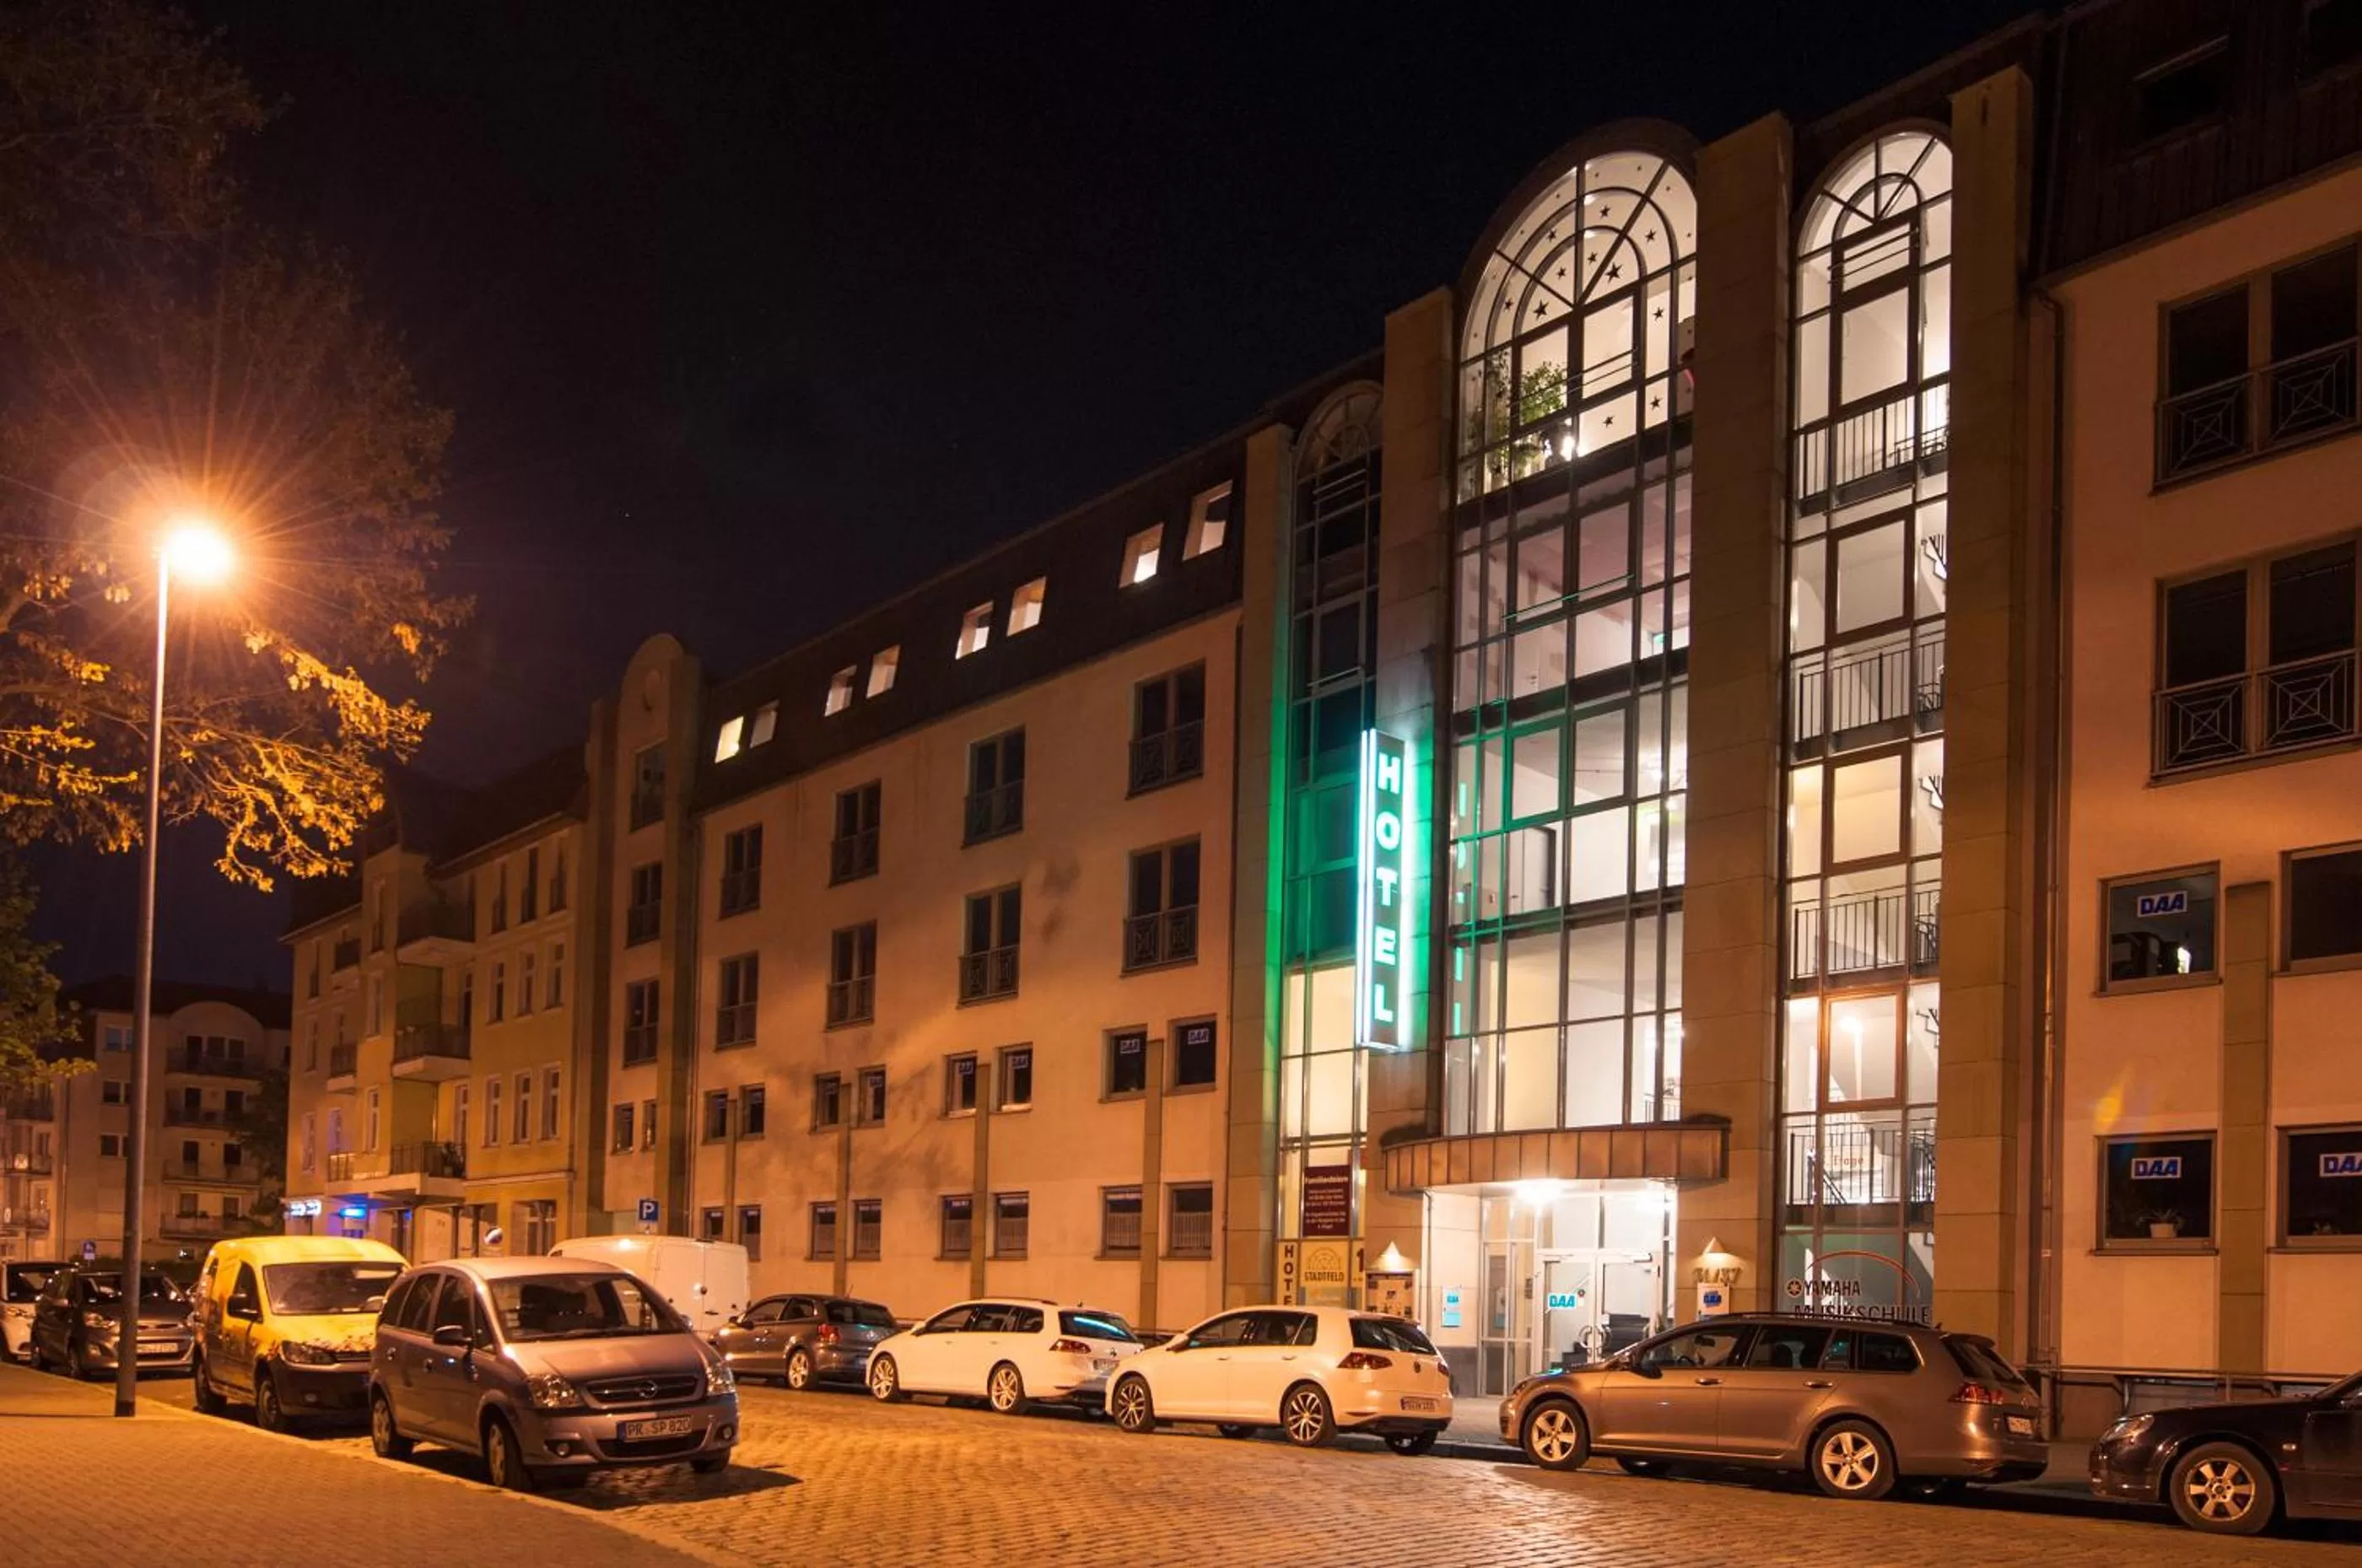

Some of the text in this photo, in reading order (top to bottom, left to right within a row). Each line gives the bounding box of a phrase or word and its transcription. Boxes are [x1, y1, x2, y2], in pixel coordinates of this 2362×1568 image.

[1373, 752, 1401, 1023] HOTEL
[2140, 893, 2185, 915] DAA
[2134, 1159, 2179, 1177] DAA
[643, 1202, 655, 1219] P
[1283, 1244, 1294, 1306] HOTE
[1304, 1271, 1344, 1282] STADTFELD
[1804, 1280, 1861, 1296] YAMAHA
[1549, 1295, 1576, 1307] DAA
